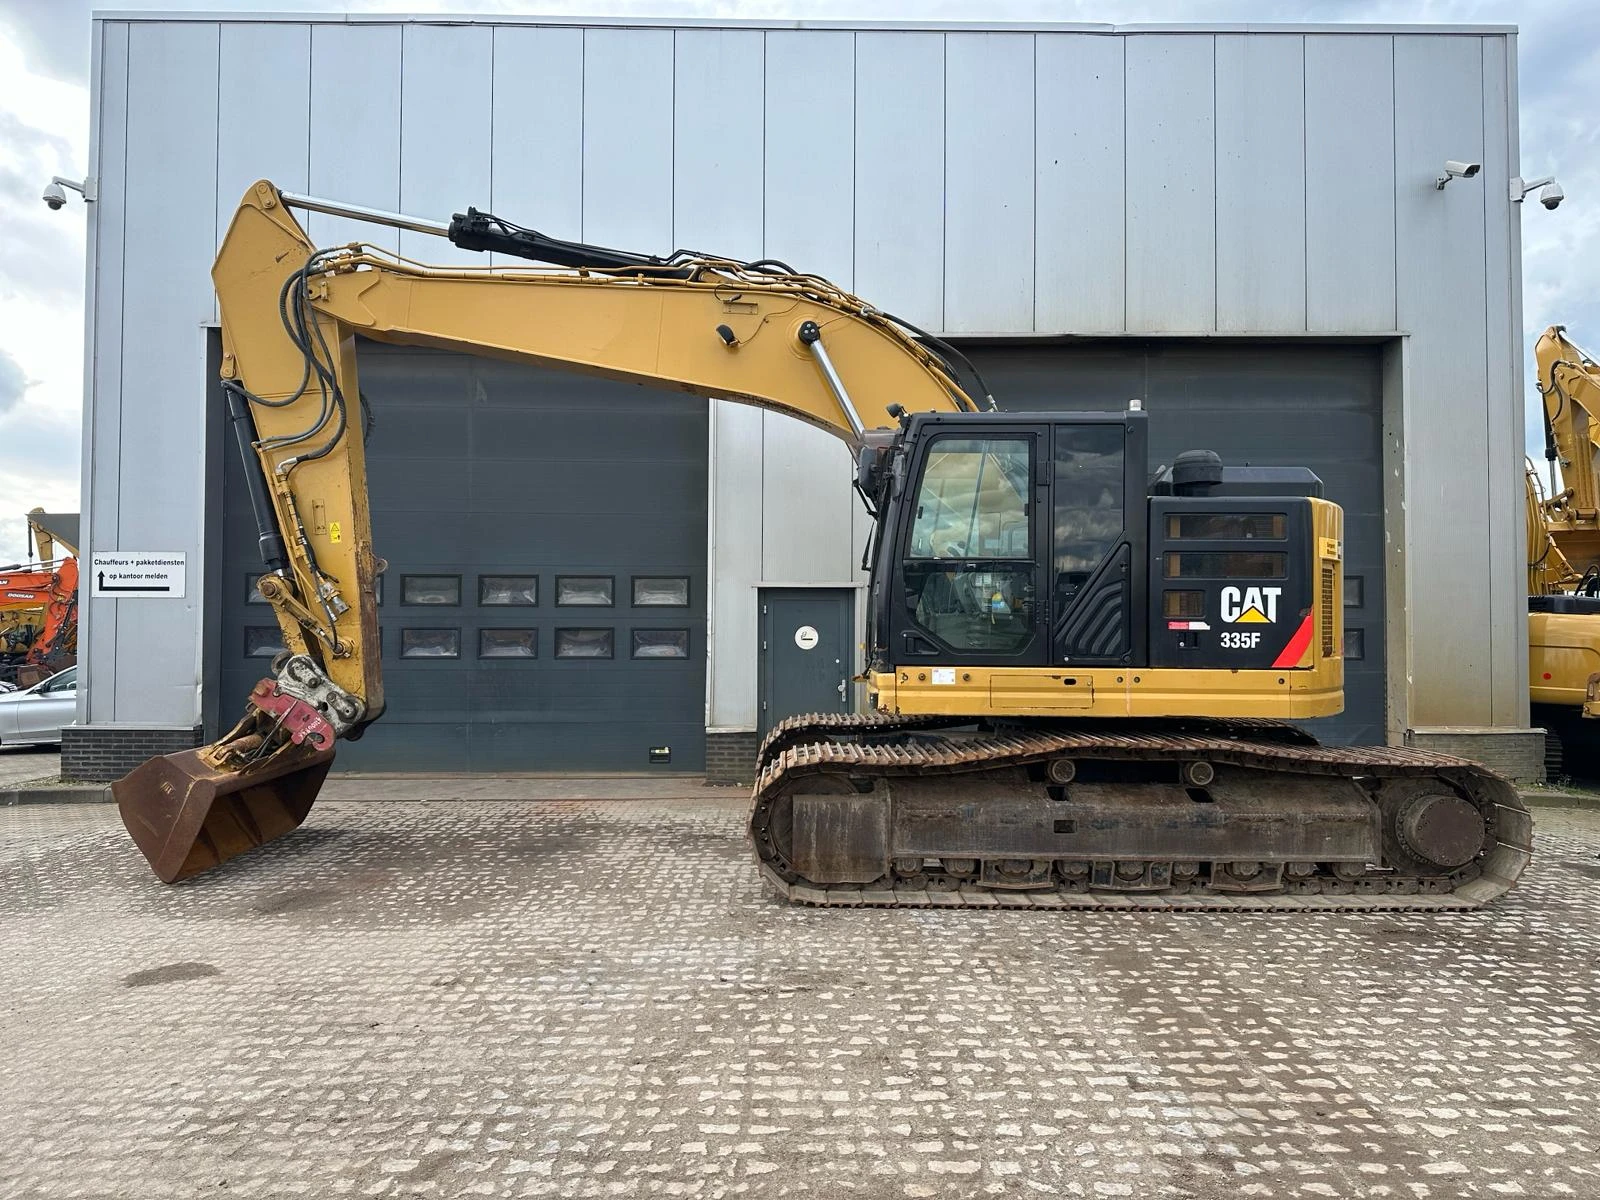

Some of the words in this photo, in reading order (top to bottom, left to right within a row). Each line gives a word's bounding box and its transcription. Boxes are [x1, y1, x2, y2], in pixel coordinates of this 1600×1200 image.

[94, 558, 129, 566] Chauffeurs
[135, 558, 185, 567] pakketdiensten
[1220, 586, 1282, 623] CAT
[1220, 632, 1261, 649] 335F
